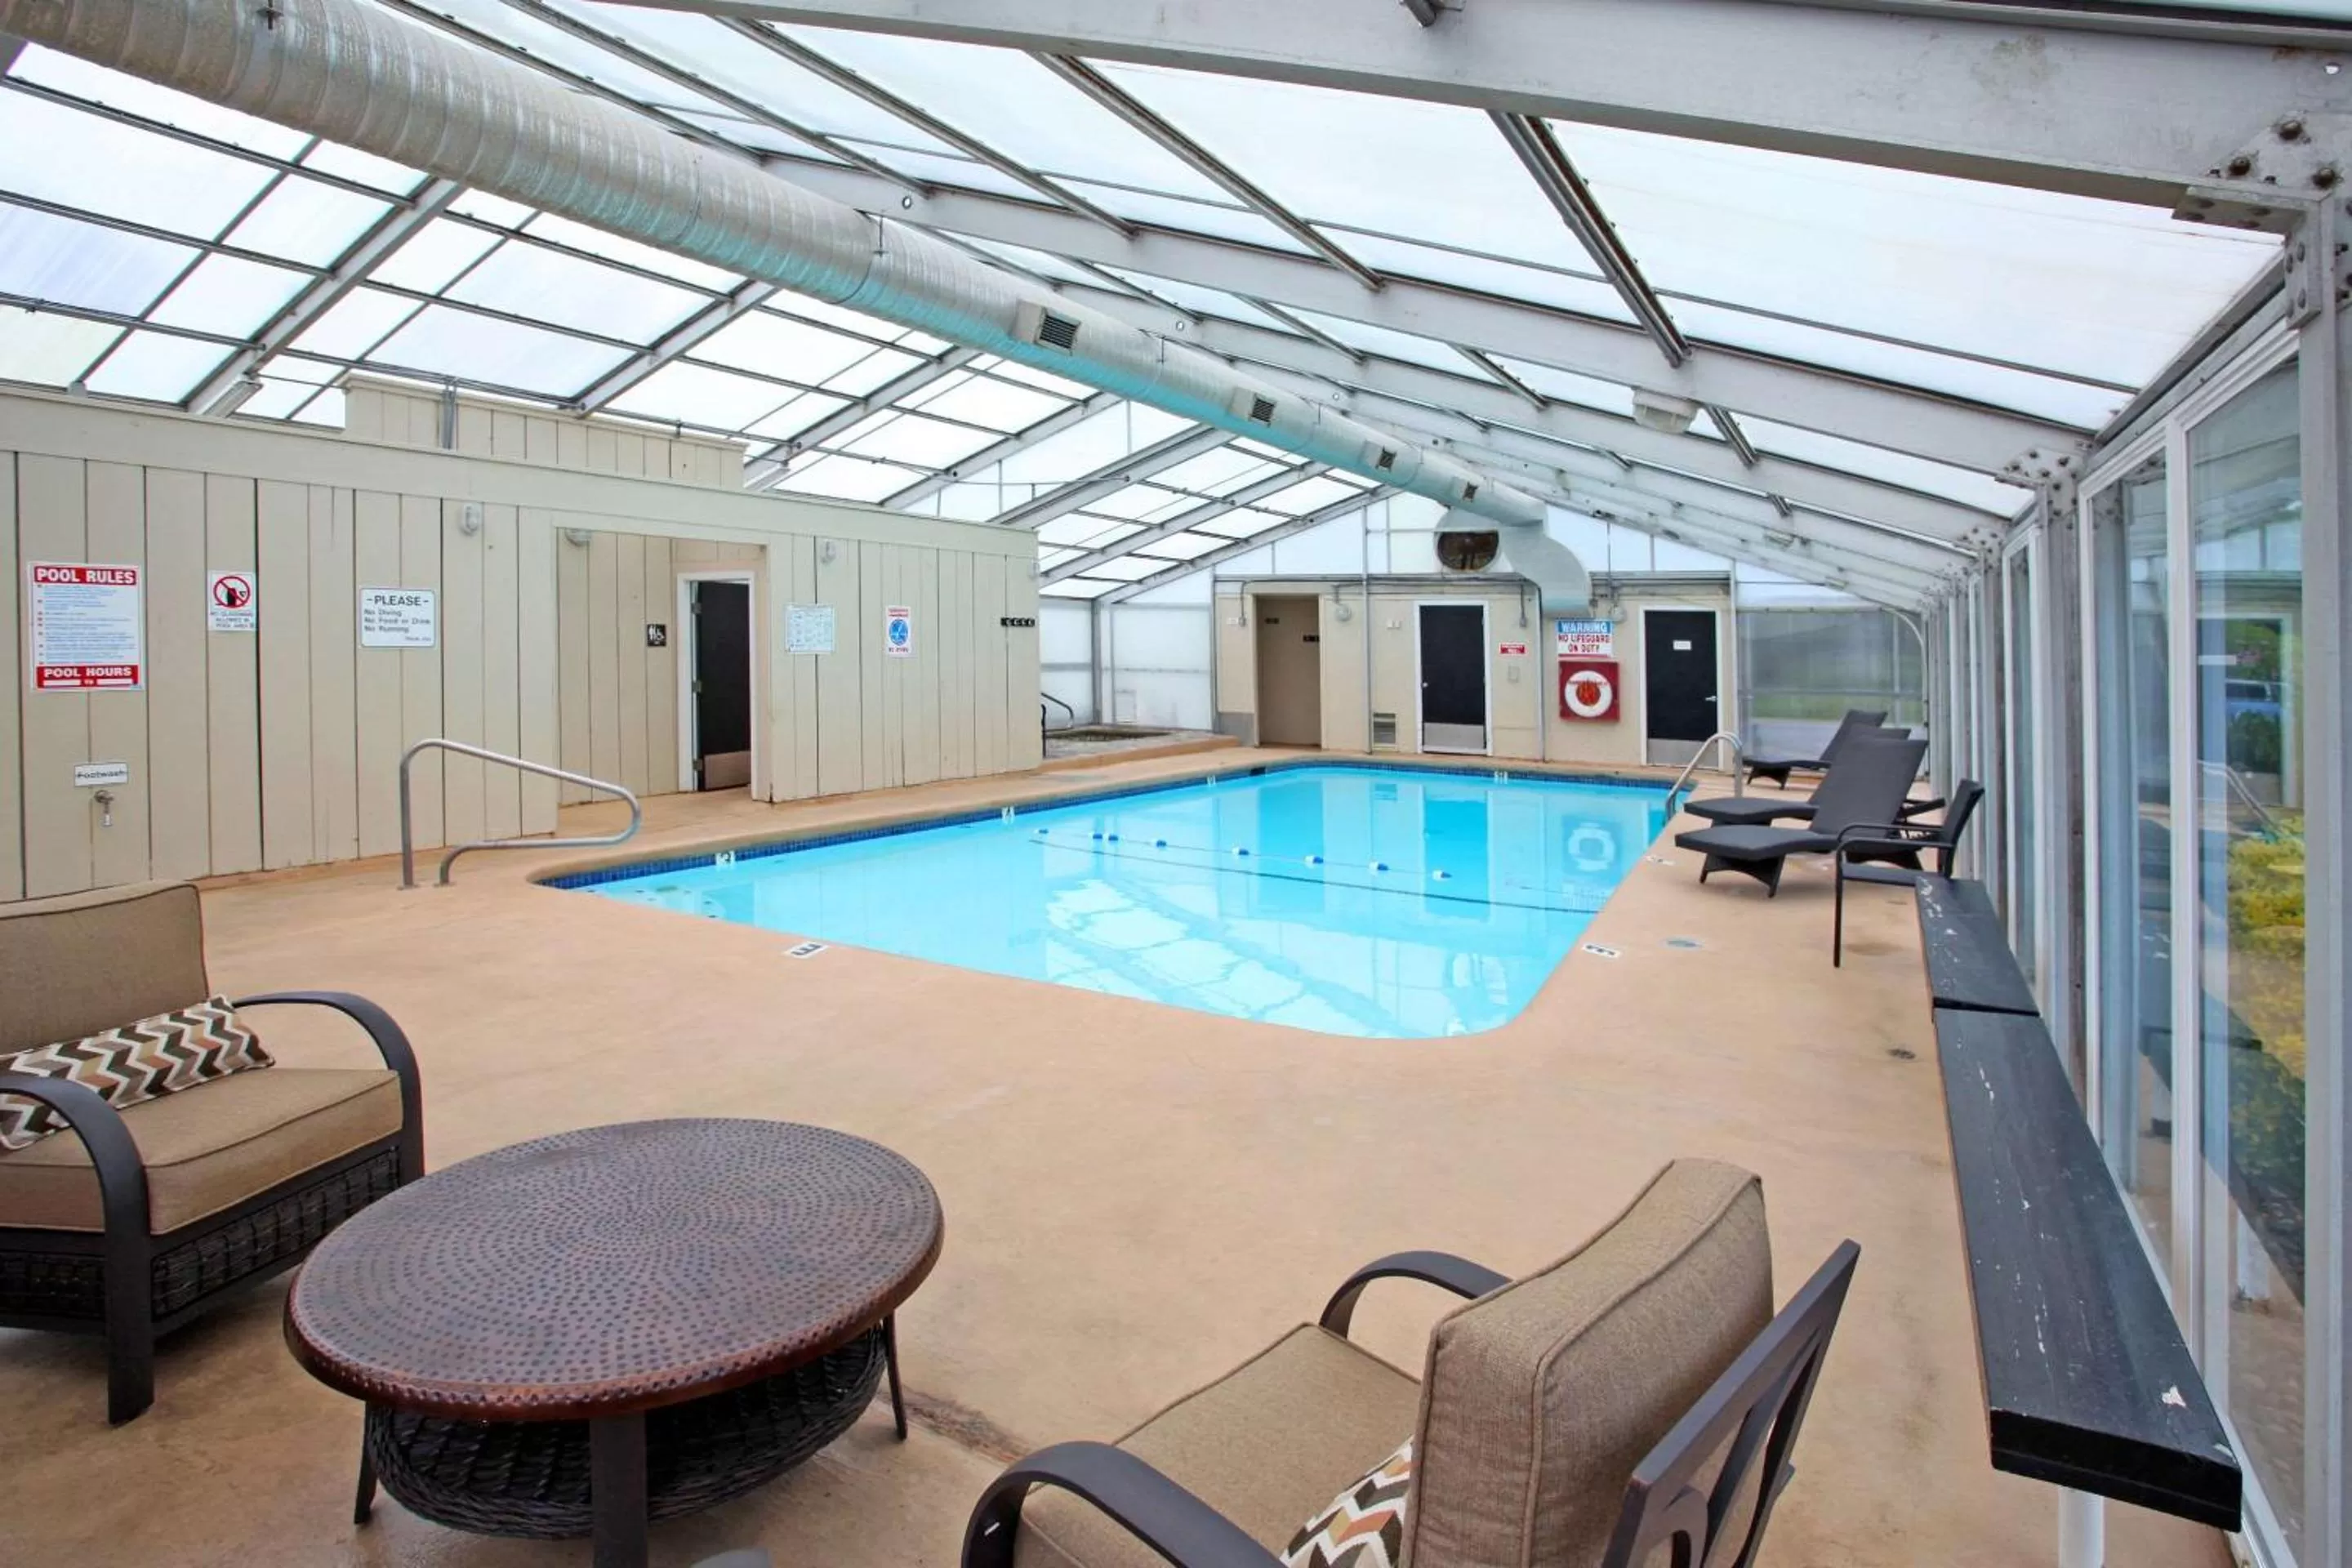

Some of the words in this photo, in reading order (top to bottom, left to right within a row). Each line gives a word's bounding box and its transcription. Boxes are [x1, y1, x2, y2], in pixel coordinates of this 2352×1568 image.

[37, 568, 80, 582] POOL
[85, 570, 135, 584] RULES
[1561, 621, 1608, 633] WARNING
[1558, 634, 1569, 642] NO
[1571, 634, 1610, 644] LIFEGUARD
[1568, 644, 1579, 653] ON
[1581, 644, 1600, 653] DUTY
[44, 667, 82, 678] POOL
[86, 666, 132, 677] HOURS
